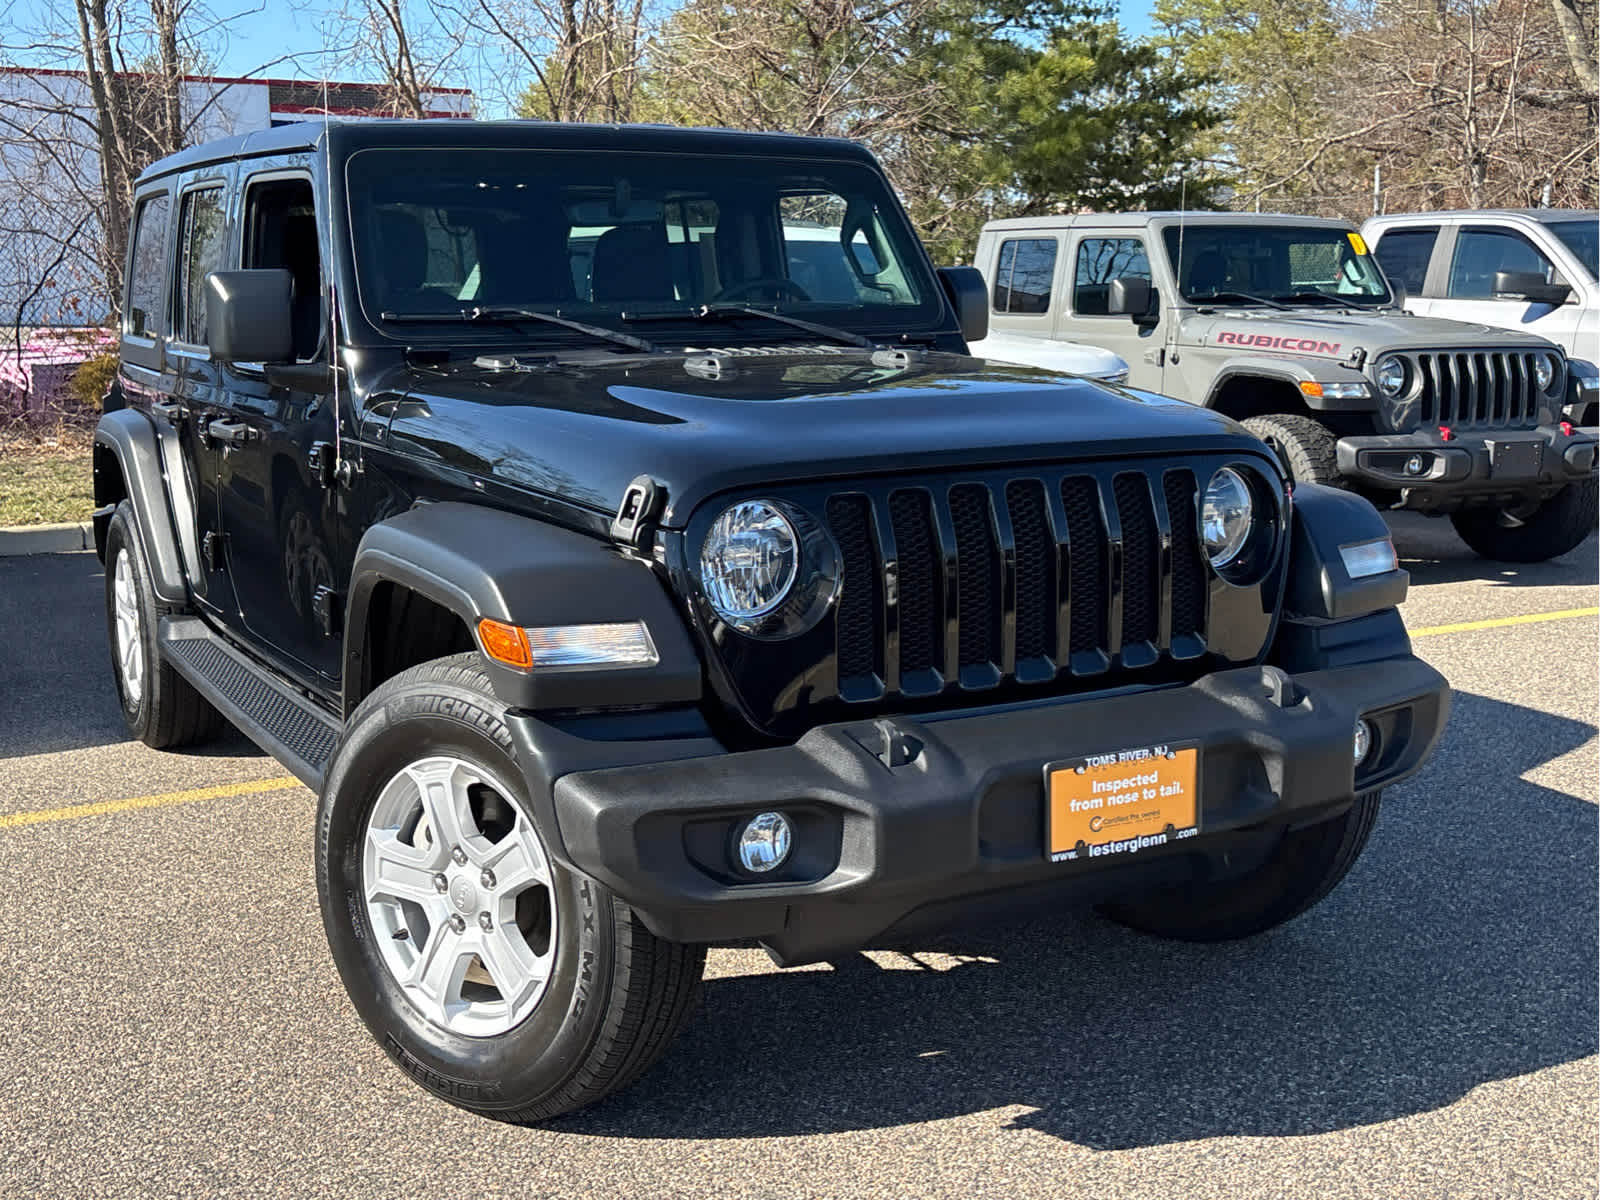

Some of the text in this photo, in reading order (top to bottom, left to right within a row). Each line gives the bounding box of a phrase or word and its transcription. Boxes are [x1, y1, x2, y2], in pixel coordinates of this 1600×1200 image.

[1217, 332, 1341, 355] RUBICON
[415, 695, 513, 747] MICHELIN
[1085, 754, 1117, 769] TOMS
[1154, 745, 1169, 757] NJ
[1092, 770, 1159, 794] Inspected
[1069, 781, 1184, 813] from nose to tail.
[1088, 833, 1167, 858] lesterglenn
